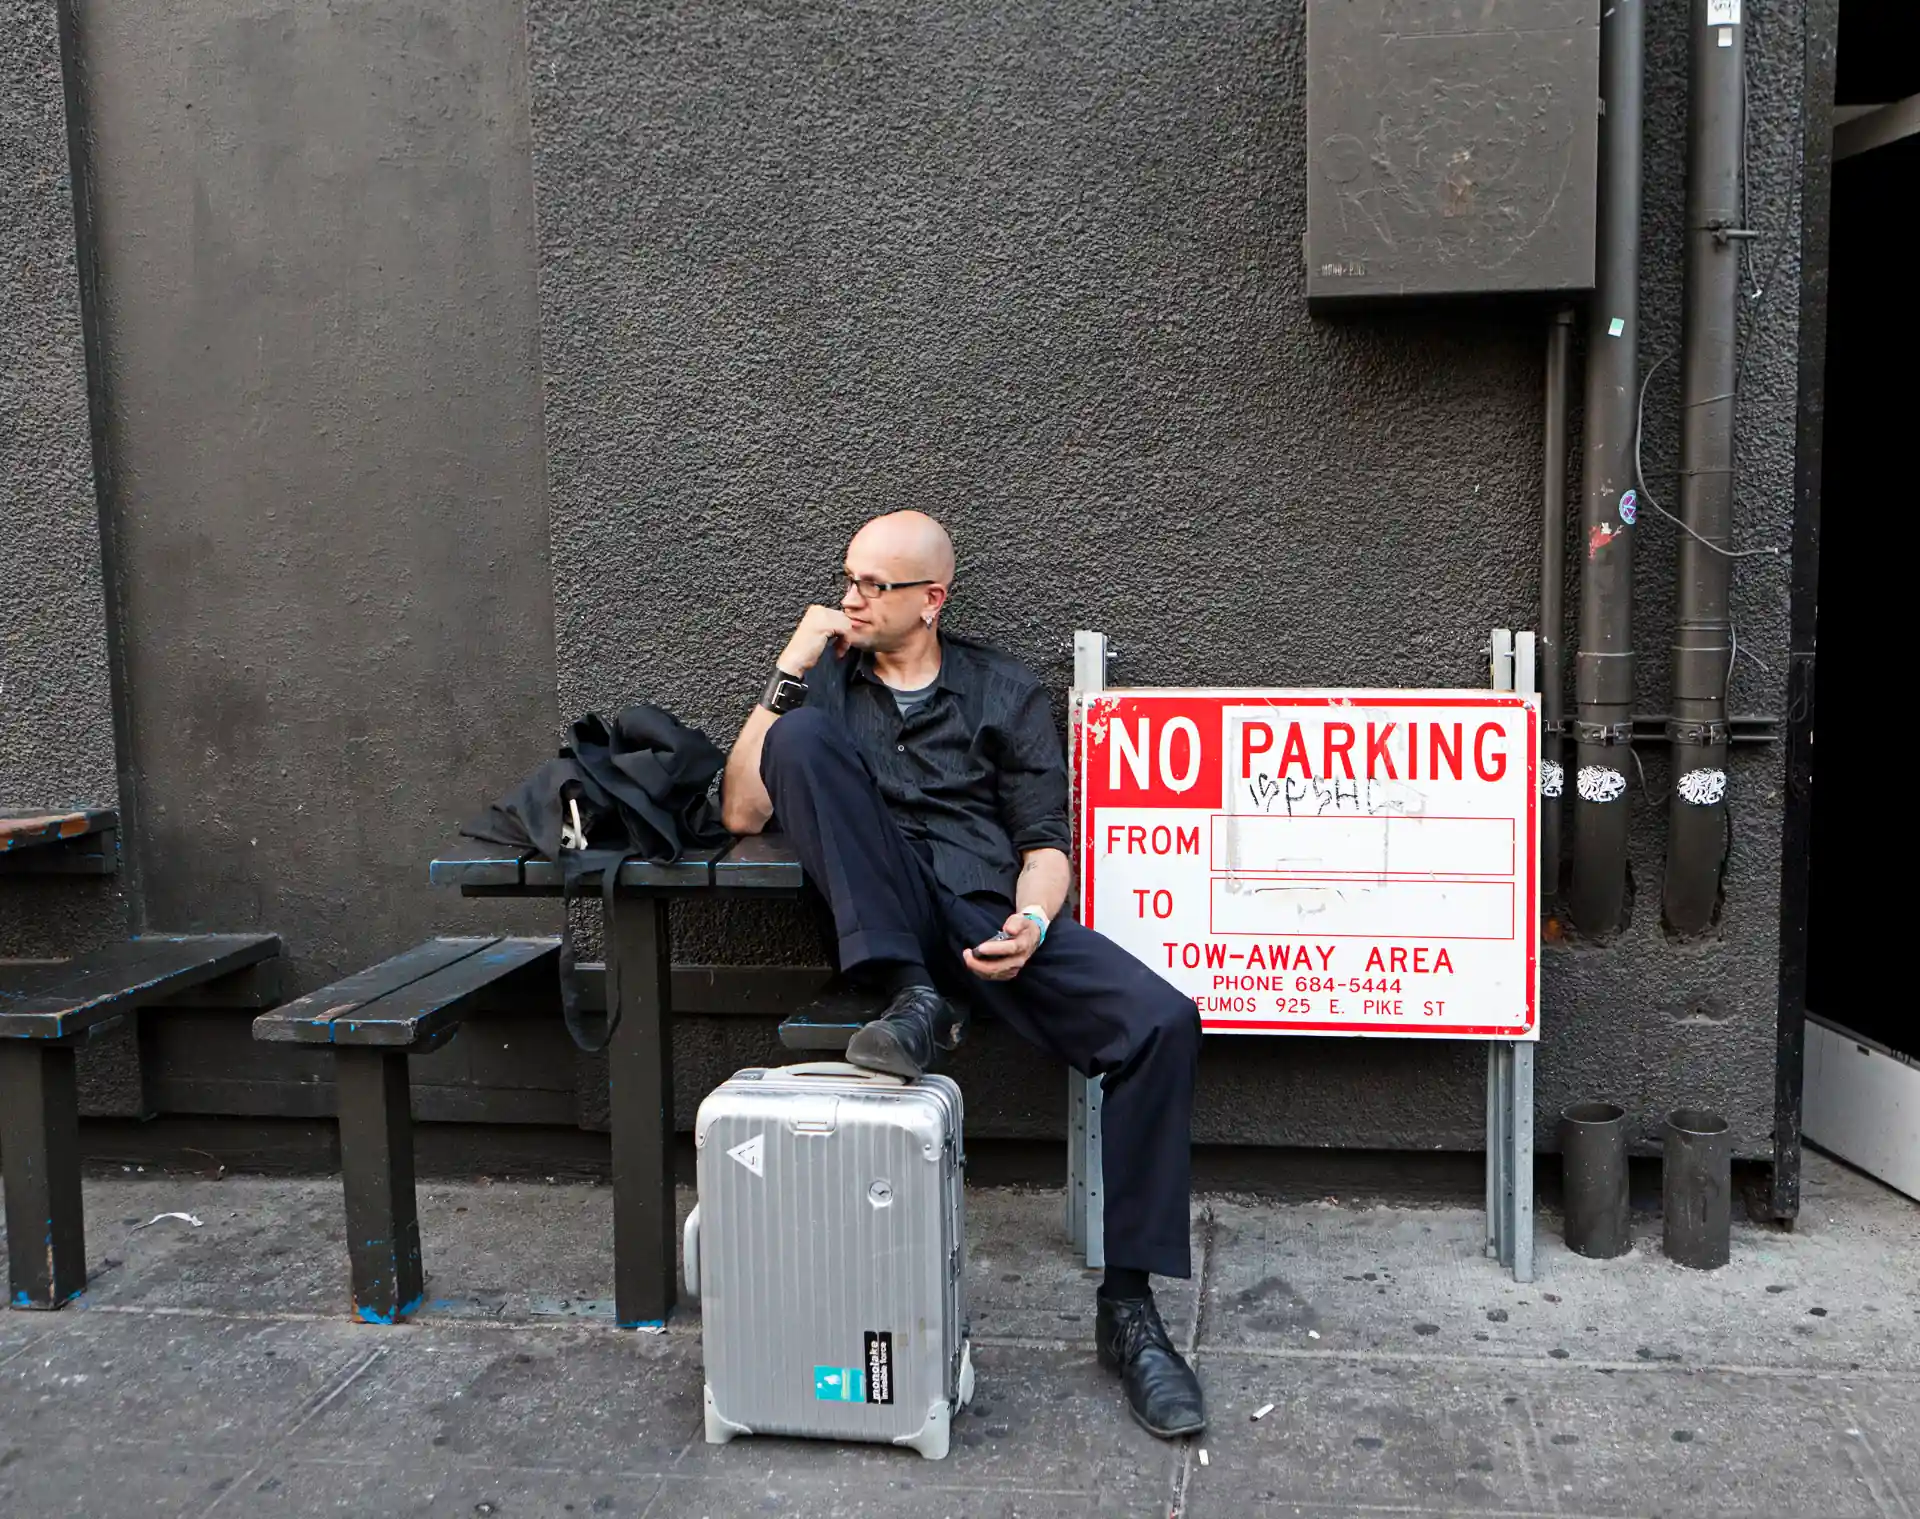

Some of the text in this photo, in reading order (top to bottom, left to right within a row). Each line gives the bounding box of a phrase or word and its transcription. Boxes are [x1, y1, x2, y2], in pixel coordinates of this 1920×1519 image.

[1108, 715, 1201, 792] NO
[1241, 721, 1507, 783] PARKING
[1107, 825, 1200, 855] FROM
[1132, 889, 1173, 919] TO
[1163, 942, 1454, 974] TOW-AWAY AREA
[1213, 975, 1402, 993] PHONE 684-5444
[1191, 996, 1446, 1016] EUMOS 925 E. PIKE ST
[869, 1340, 880, 1400] monolake
